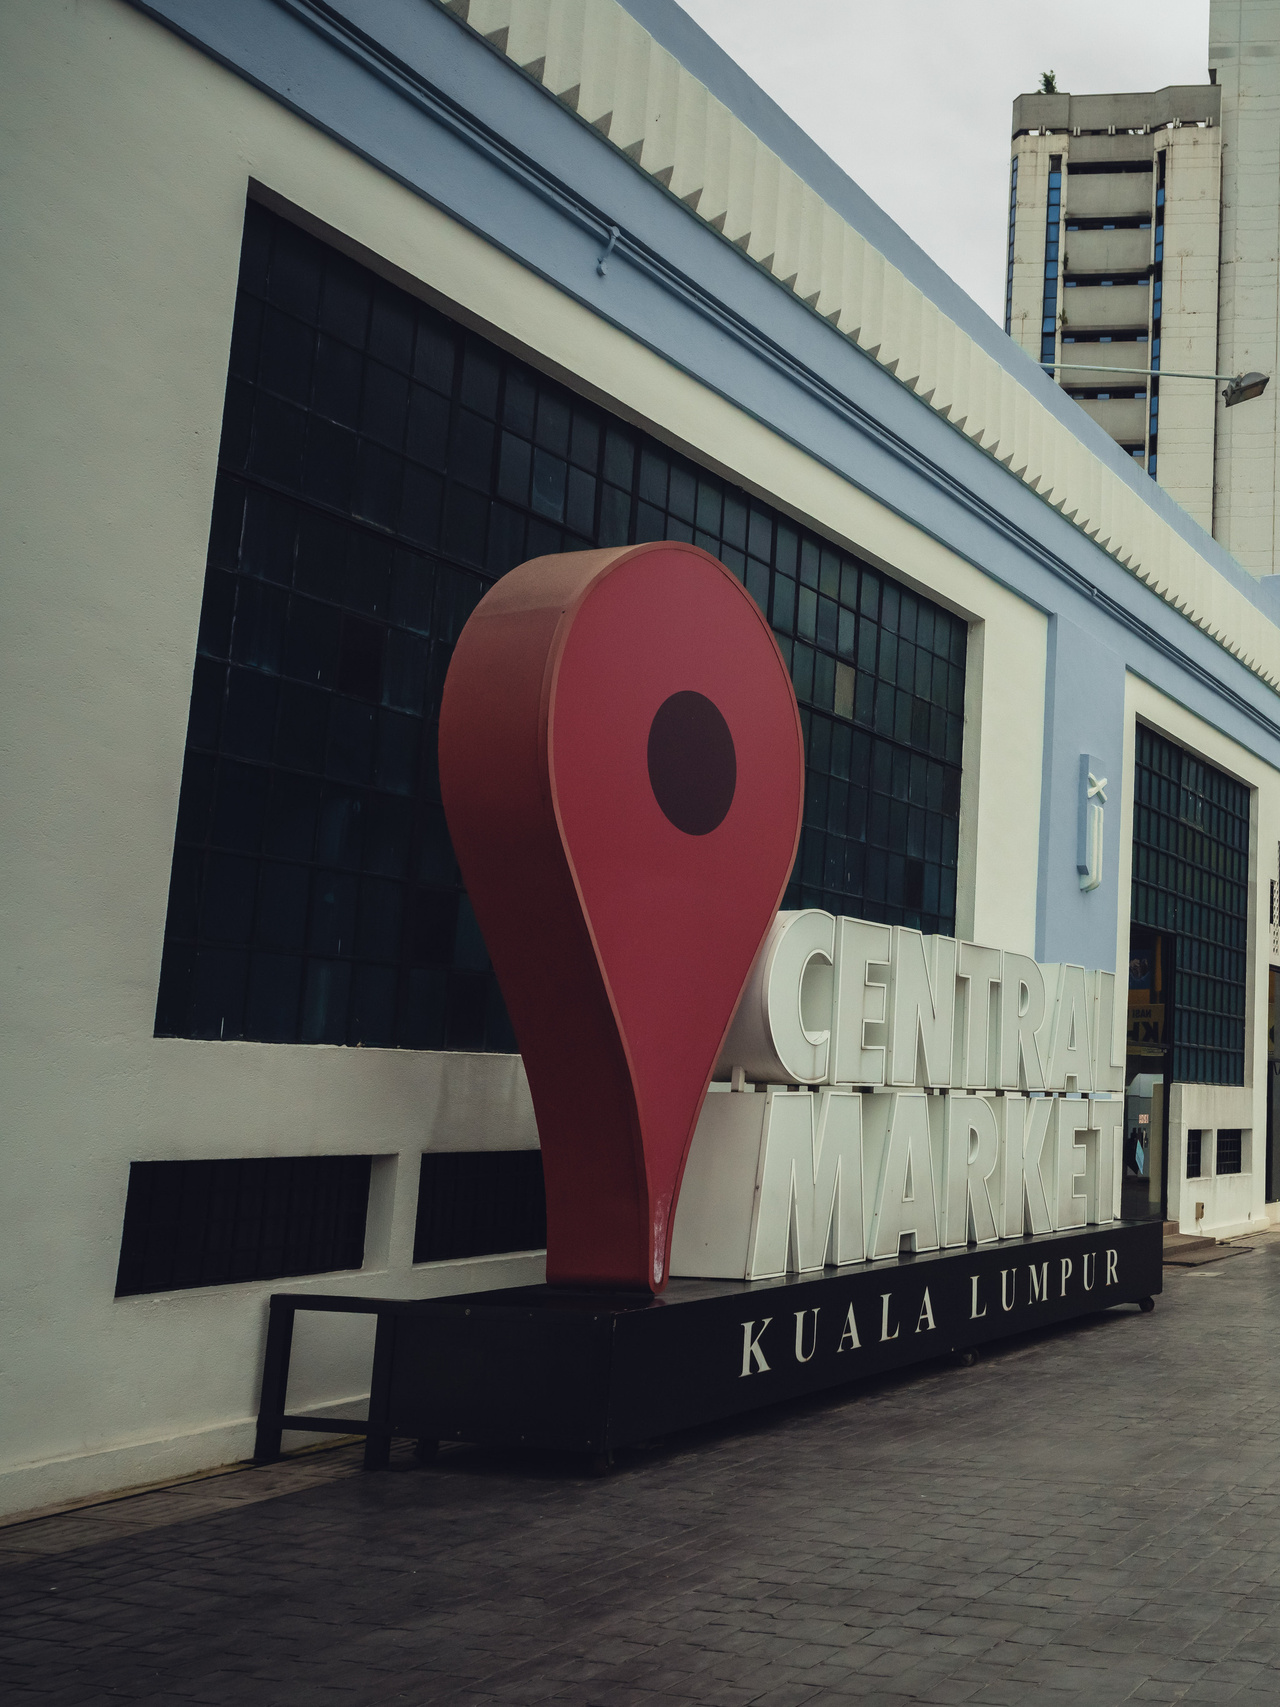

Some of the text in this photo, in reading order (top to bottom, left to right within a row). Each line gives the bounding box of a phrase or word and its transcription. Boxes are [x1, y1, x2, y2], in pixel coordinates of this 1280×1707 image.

[767, 908, 1123, 1093] CENTRAL
[745, 1092, 1123, 1281] MARKET
[738, 1248, 1121, 1379] KUALA LUMPUR
